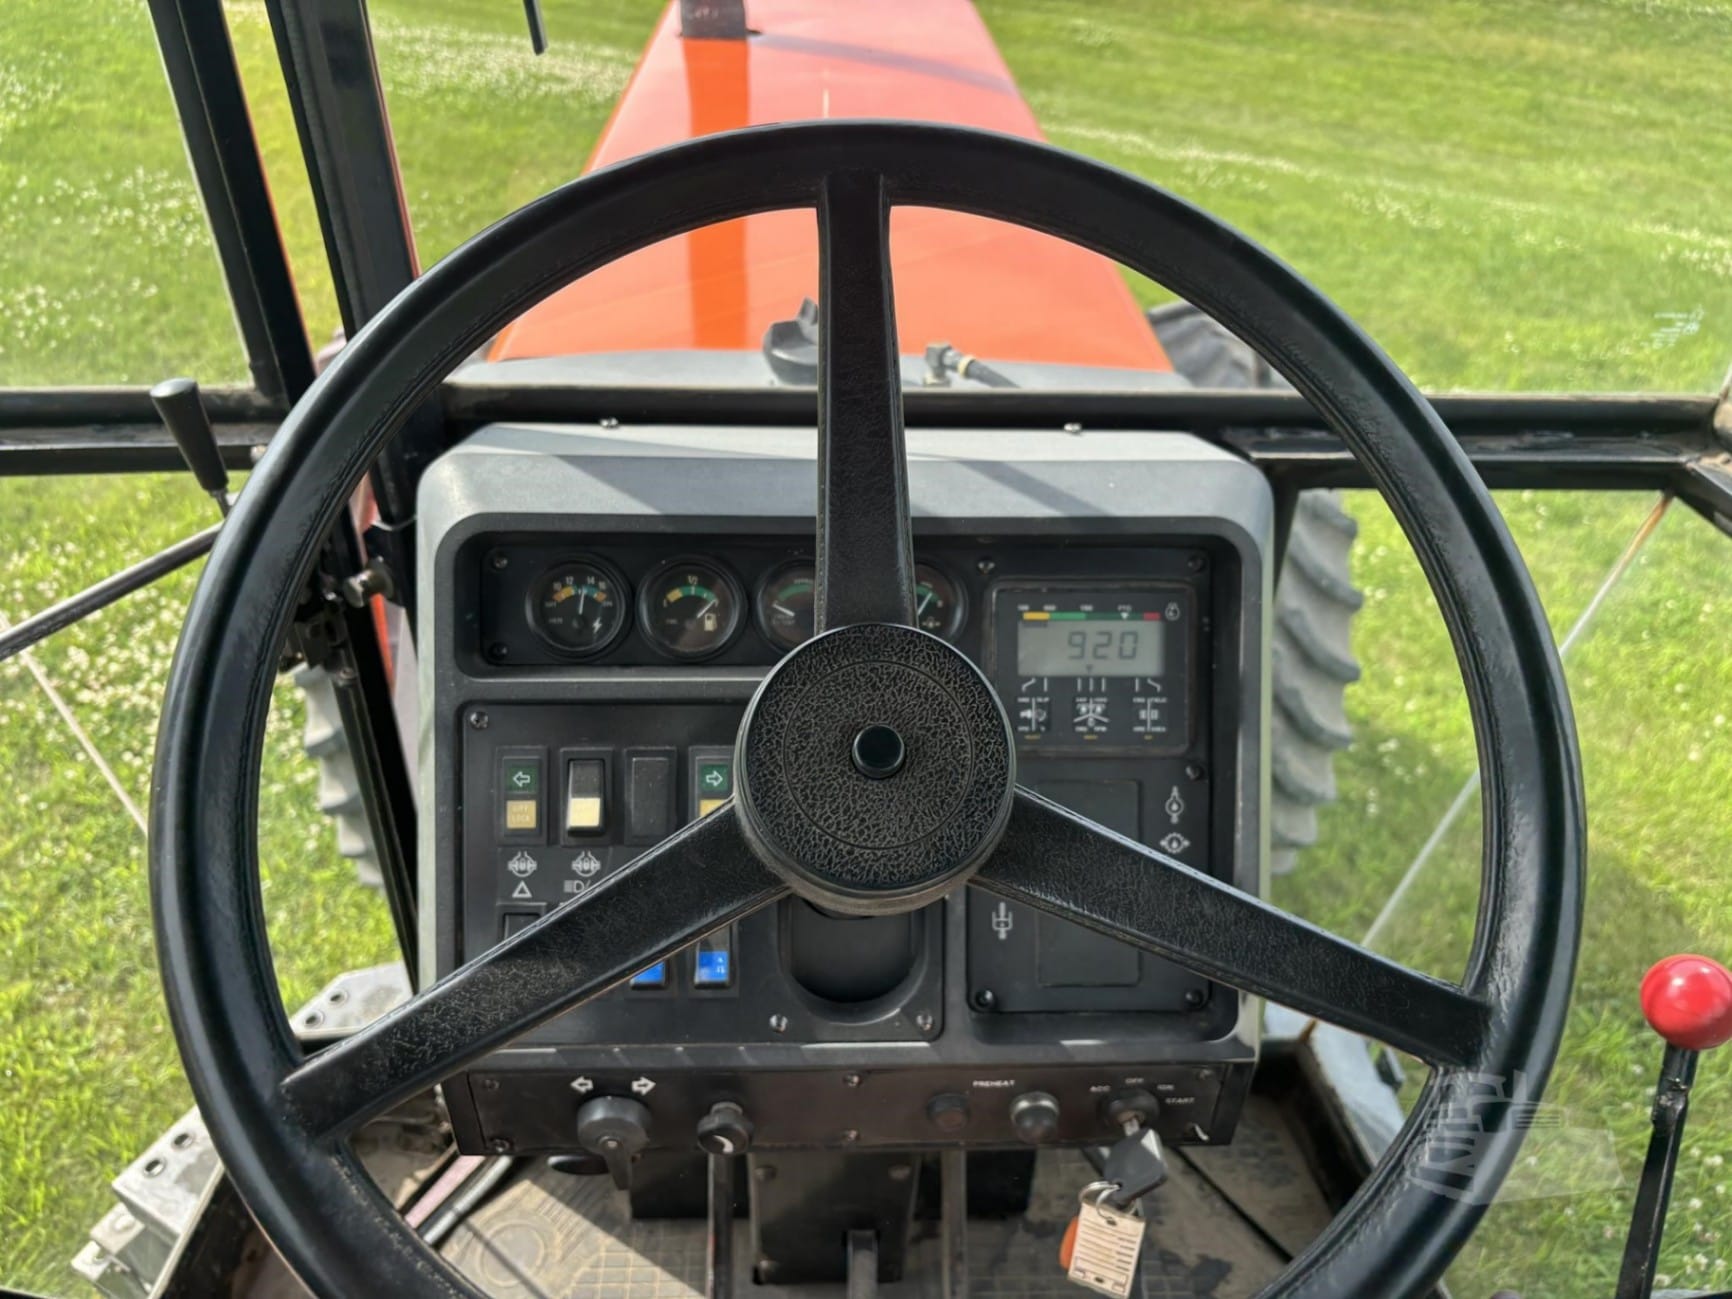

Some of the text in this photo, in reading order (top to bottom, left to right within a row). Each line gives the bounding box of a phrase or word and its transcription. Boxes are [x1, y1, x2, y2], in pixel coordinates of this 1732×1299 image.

[1067, 631, 1139, 660] 920
[972, 1079, 1016, 1088] PREHEAT
[1165, 1096, 1196, 1105] START
